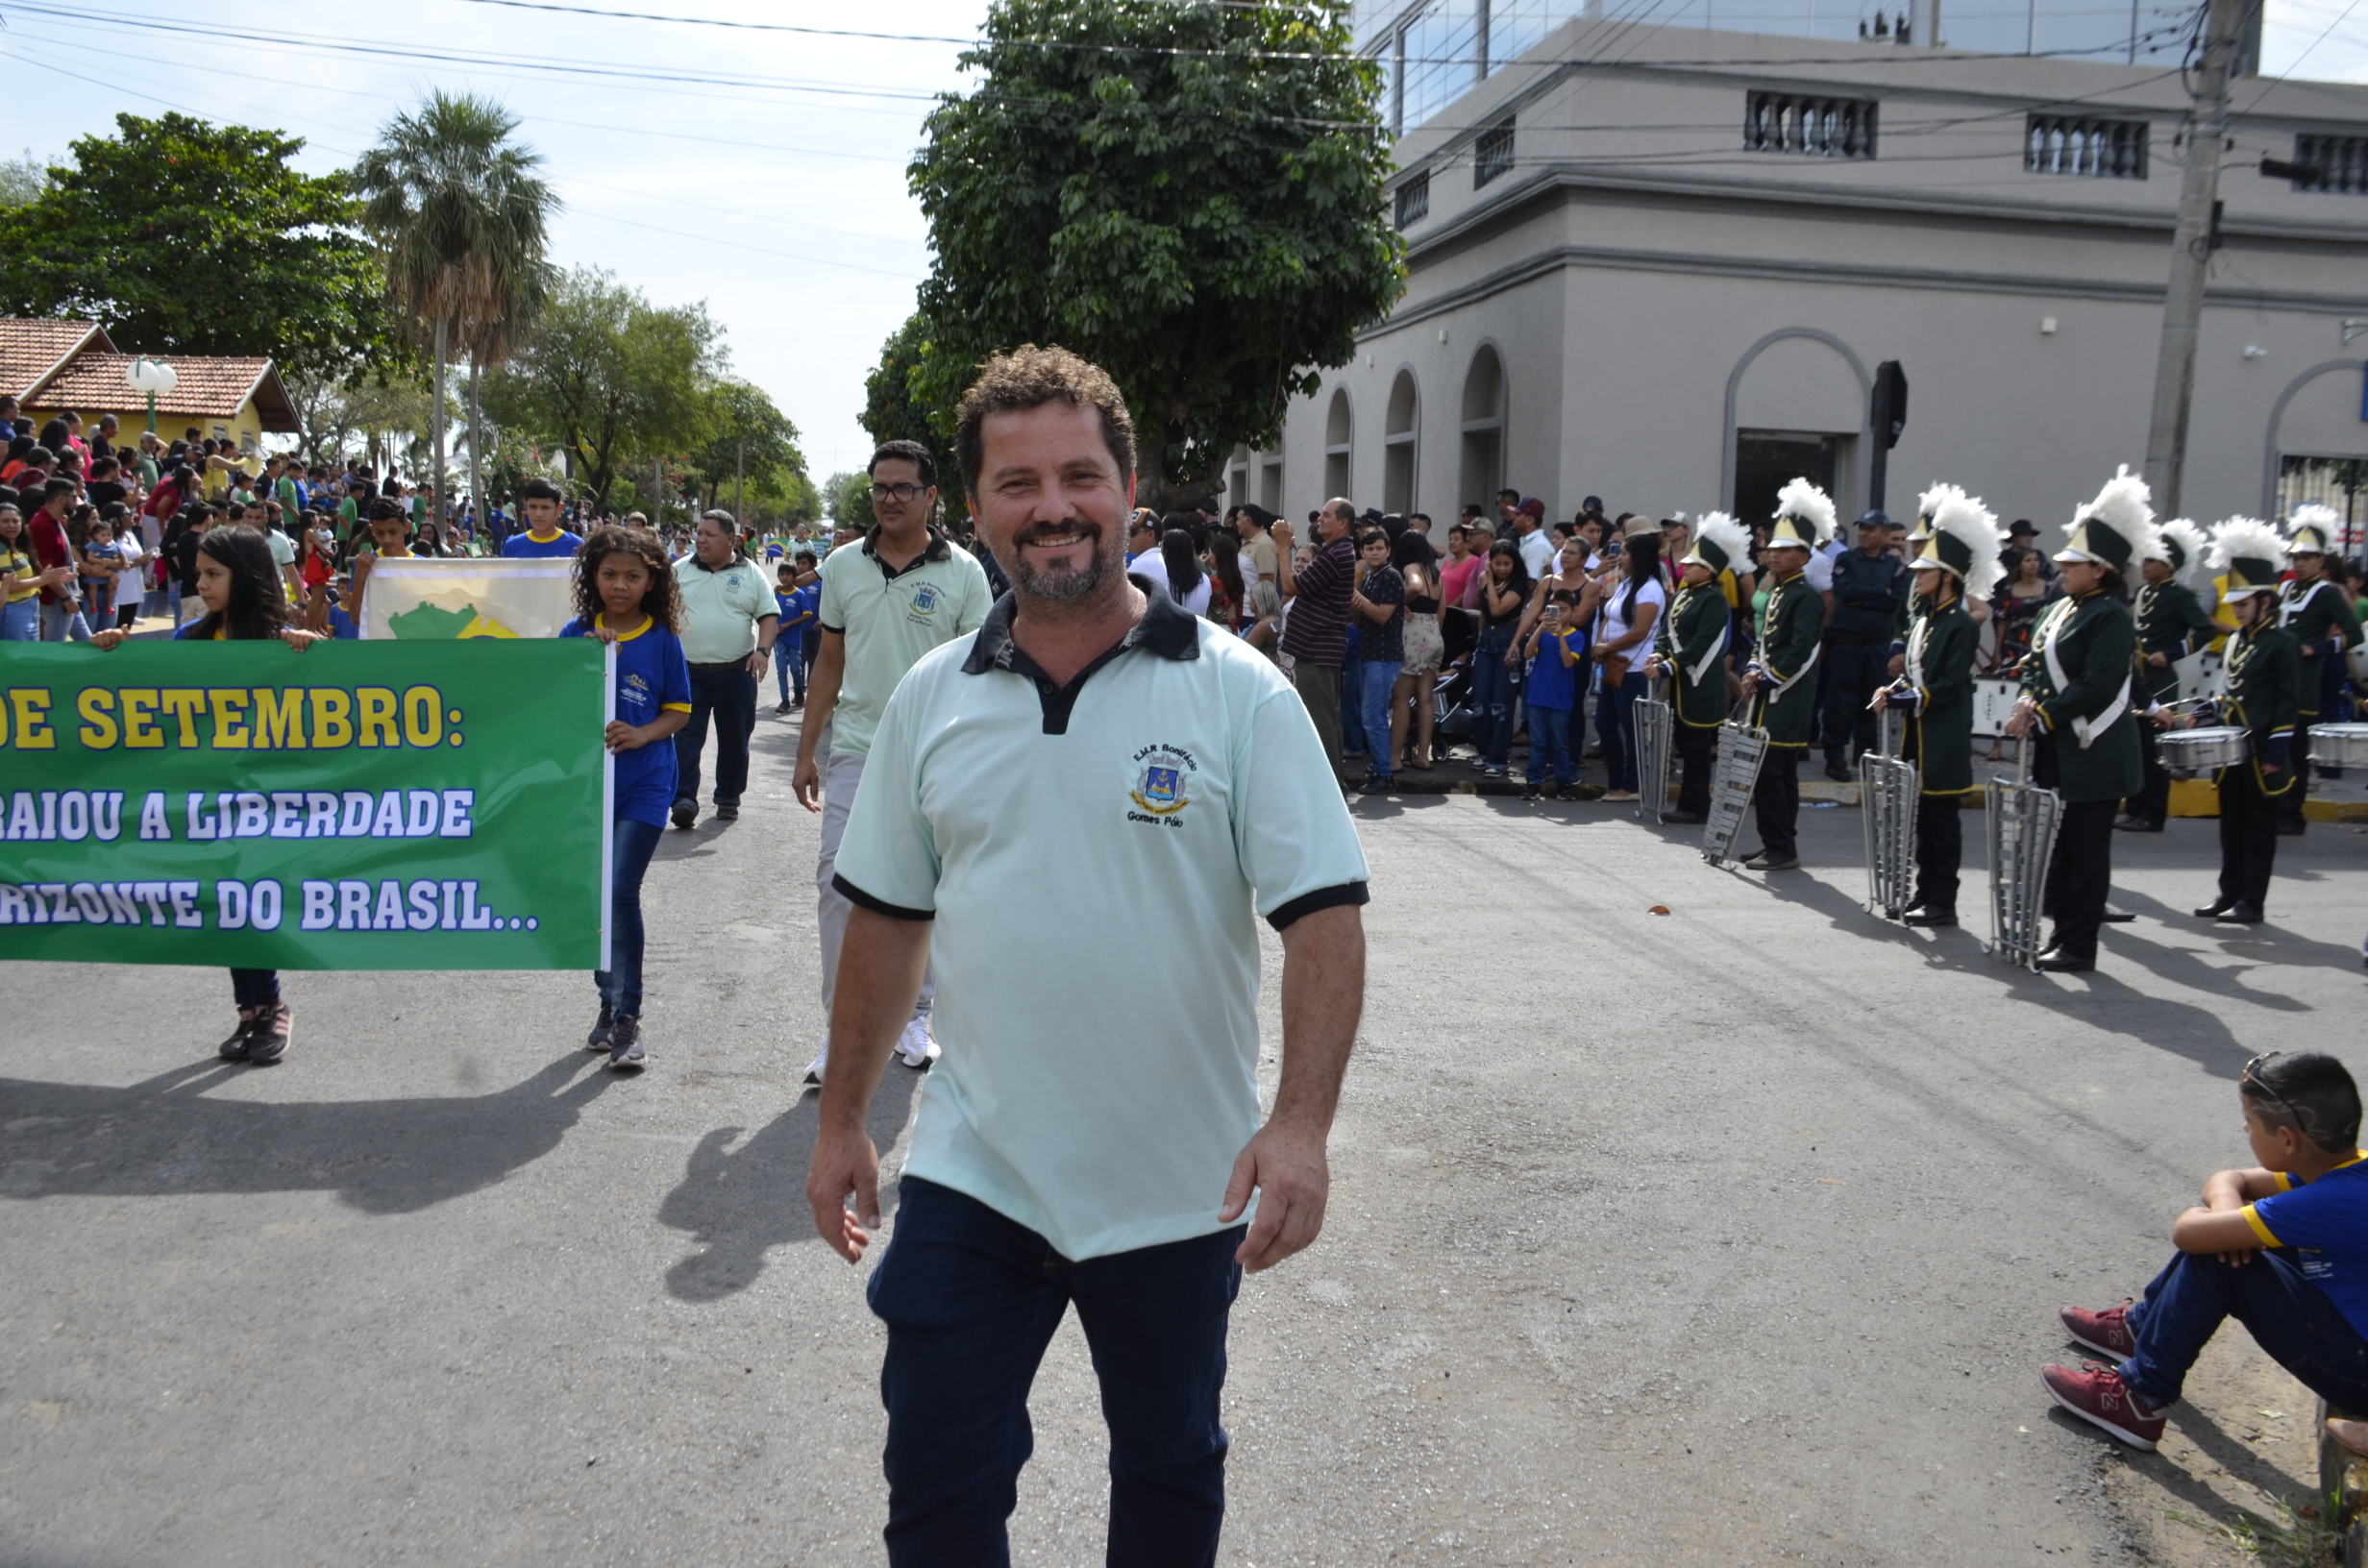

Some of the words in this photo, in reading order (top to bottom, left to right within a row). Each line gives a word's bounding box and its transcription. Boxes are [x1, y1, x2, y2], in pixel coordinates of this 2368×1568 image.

[0, 686, 55, 750] E
[76, 684, 465, 750] SETEMBRO:
[1162, 744, 1197, 772] Bonifácio
[0, 790, 126, 842] AIOU
[138, 791, 172, 841] A
[186, 788, 476, 840] LIBERDADE
[1127, 811, 1160, 825] Gomes
[1164, 816, 1183, 828] Pólo
[216, 878, 283, 931] DO
[300, 878, 540, 932] BRASIL...
[2109, 1330, 2124, 1345] N
[2100, 1392, 2119, 1410] N
